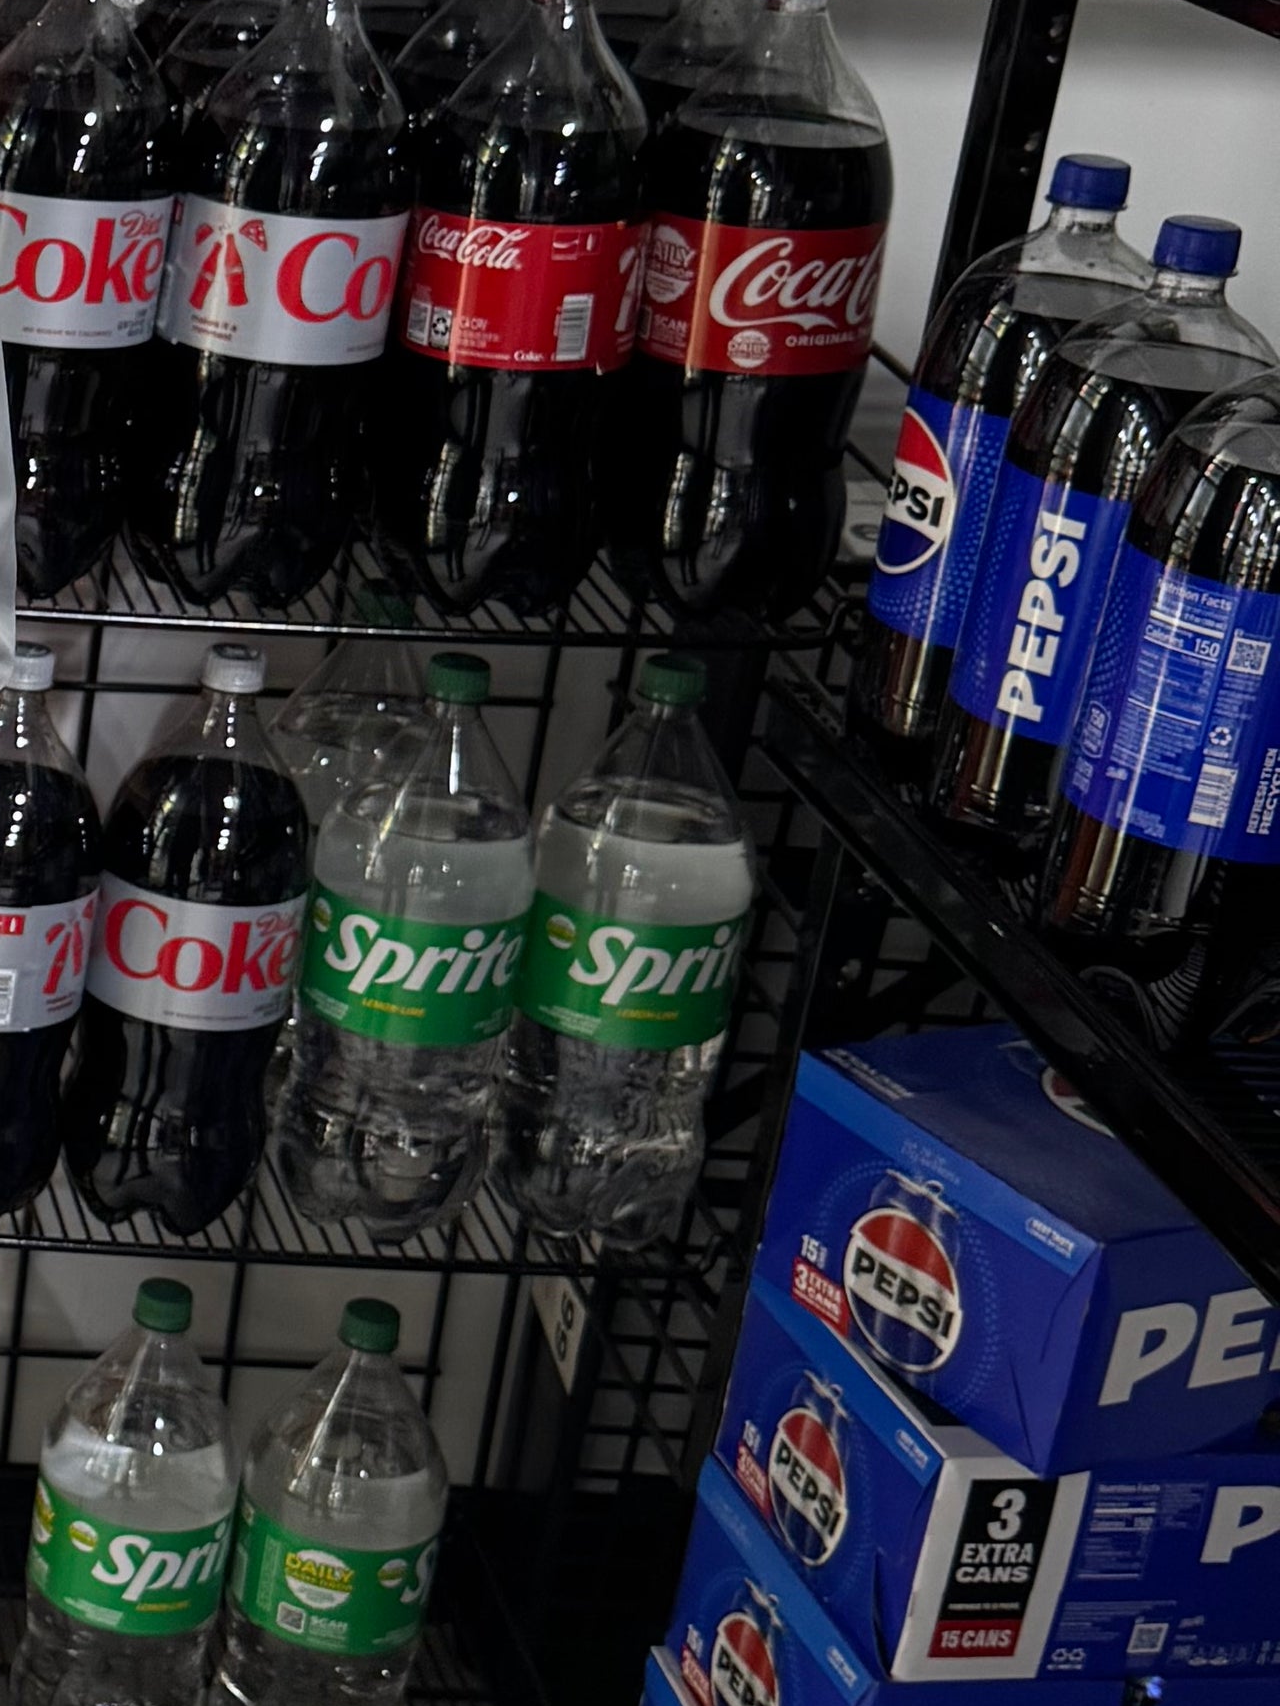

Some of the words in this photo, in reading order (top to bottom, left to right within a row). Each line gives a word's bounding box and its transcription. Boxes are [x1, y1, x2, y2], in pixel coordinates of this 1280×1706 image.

[996, 511, 1087, 723] PEPSI
[1194, 637, 1220, 658] 150
[105, 897, 297, 995] Coke
[324, 913, 523, 994] Sprite
[852, 1247, 955, 1339] PEPSI
[775, 1438, 842, 1536] PEPSI
[986, 1488, 1027, 1542] 3
[285, 1552, 356, 1583] DAILY
[954, 1565, 1030, 1584] CANS
[959, 1542, 1034, 1565] EXTRA
[940, 1630, 959, 1648] 15
[961, 1629, 1012, 1649] CANS
